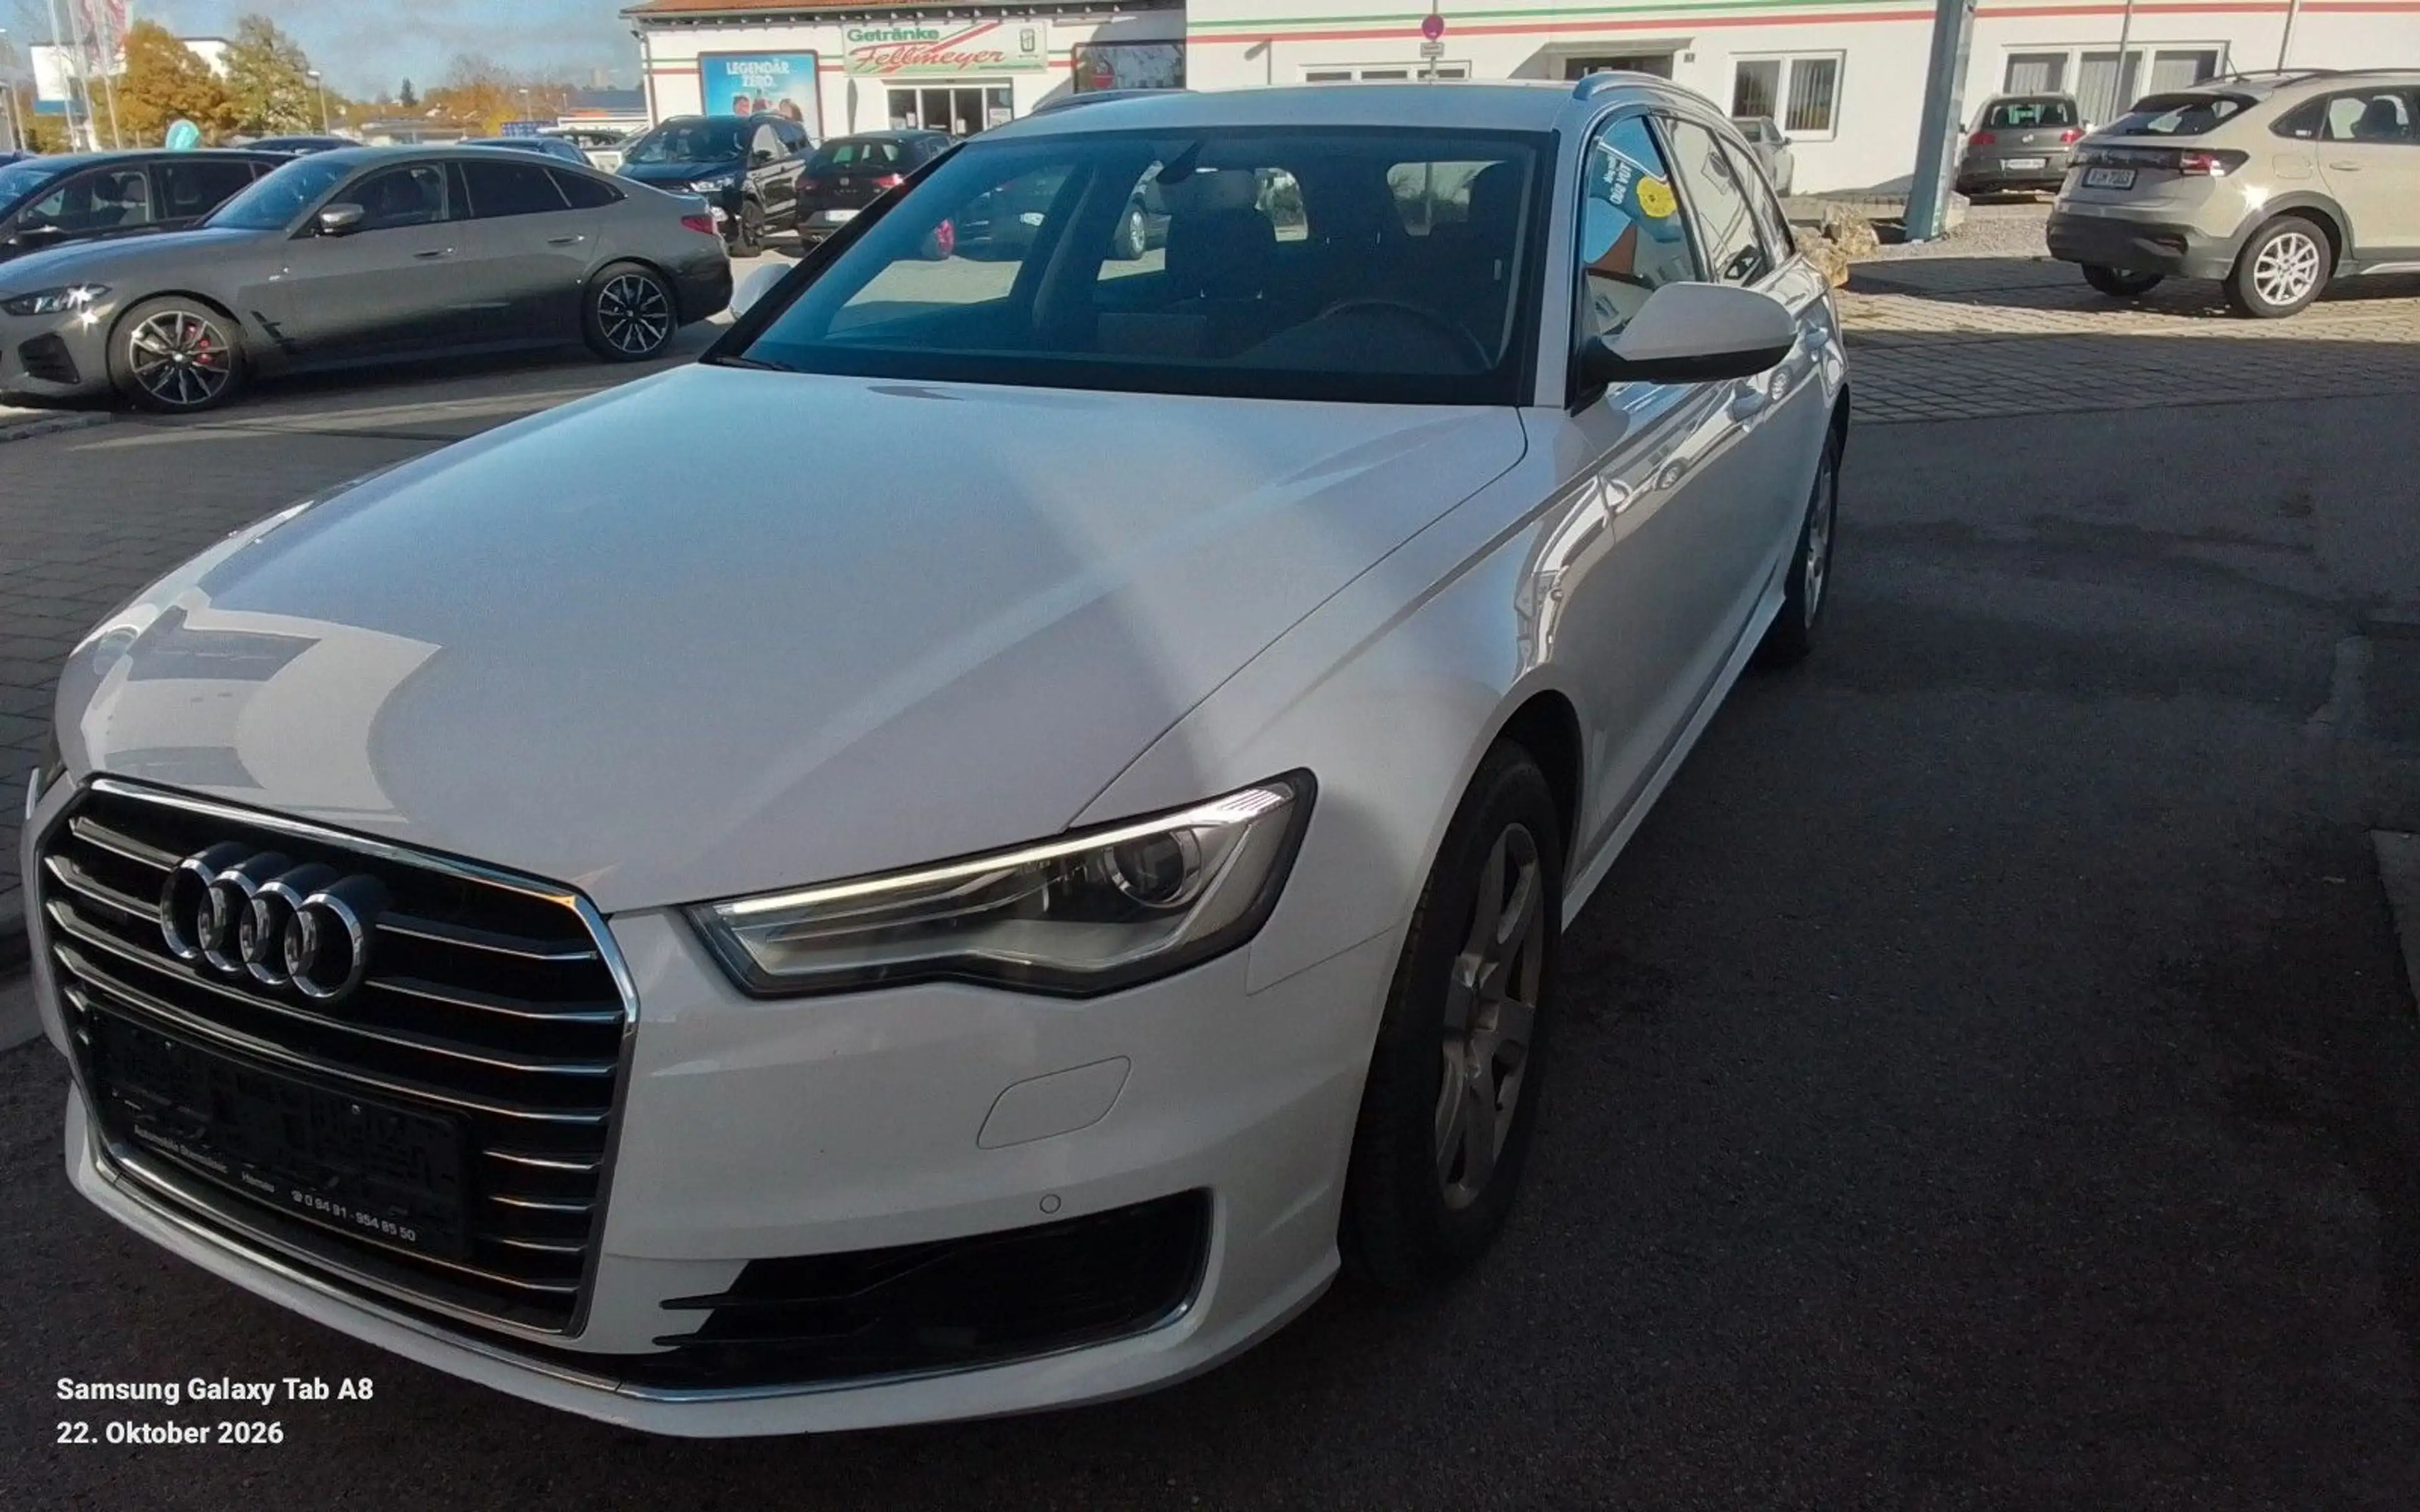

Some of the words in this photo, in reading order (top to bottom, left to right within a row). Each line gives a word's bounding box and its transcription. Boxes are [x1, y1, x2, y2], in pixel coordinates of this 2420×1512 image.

[847, 28, 939, 42] Getränke
[726, 58, 790, 74] LEGENDÄR
[849, 45, 1005, 71] Fellmeyer
[399, 1226, 416, 1242] 50
